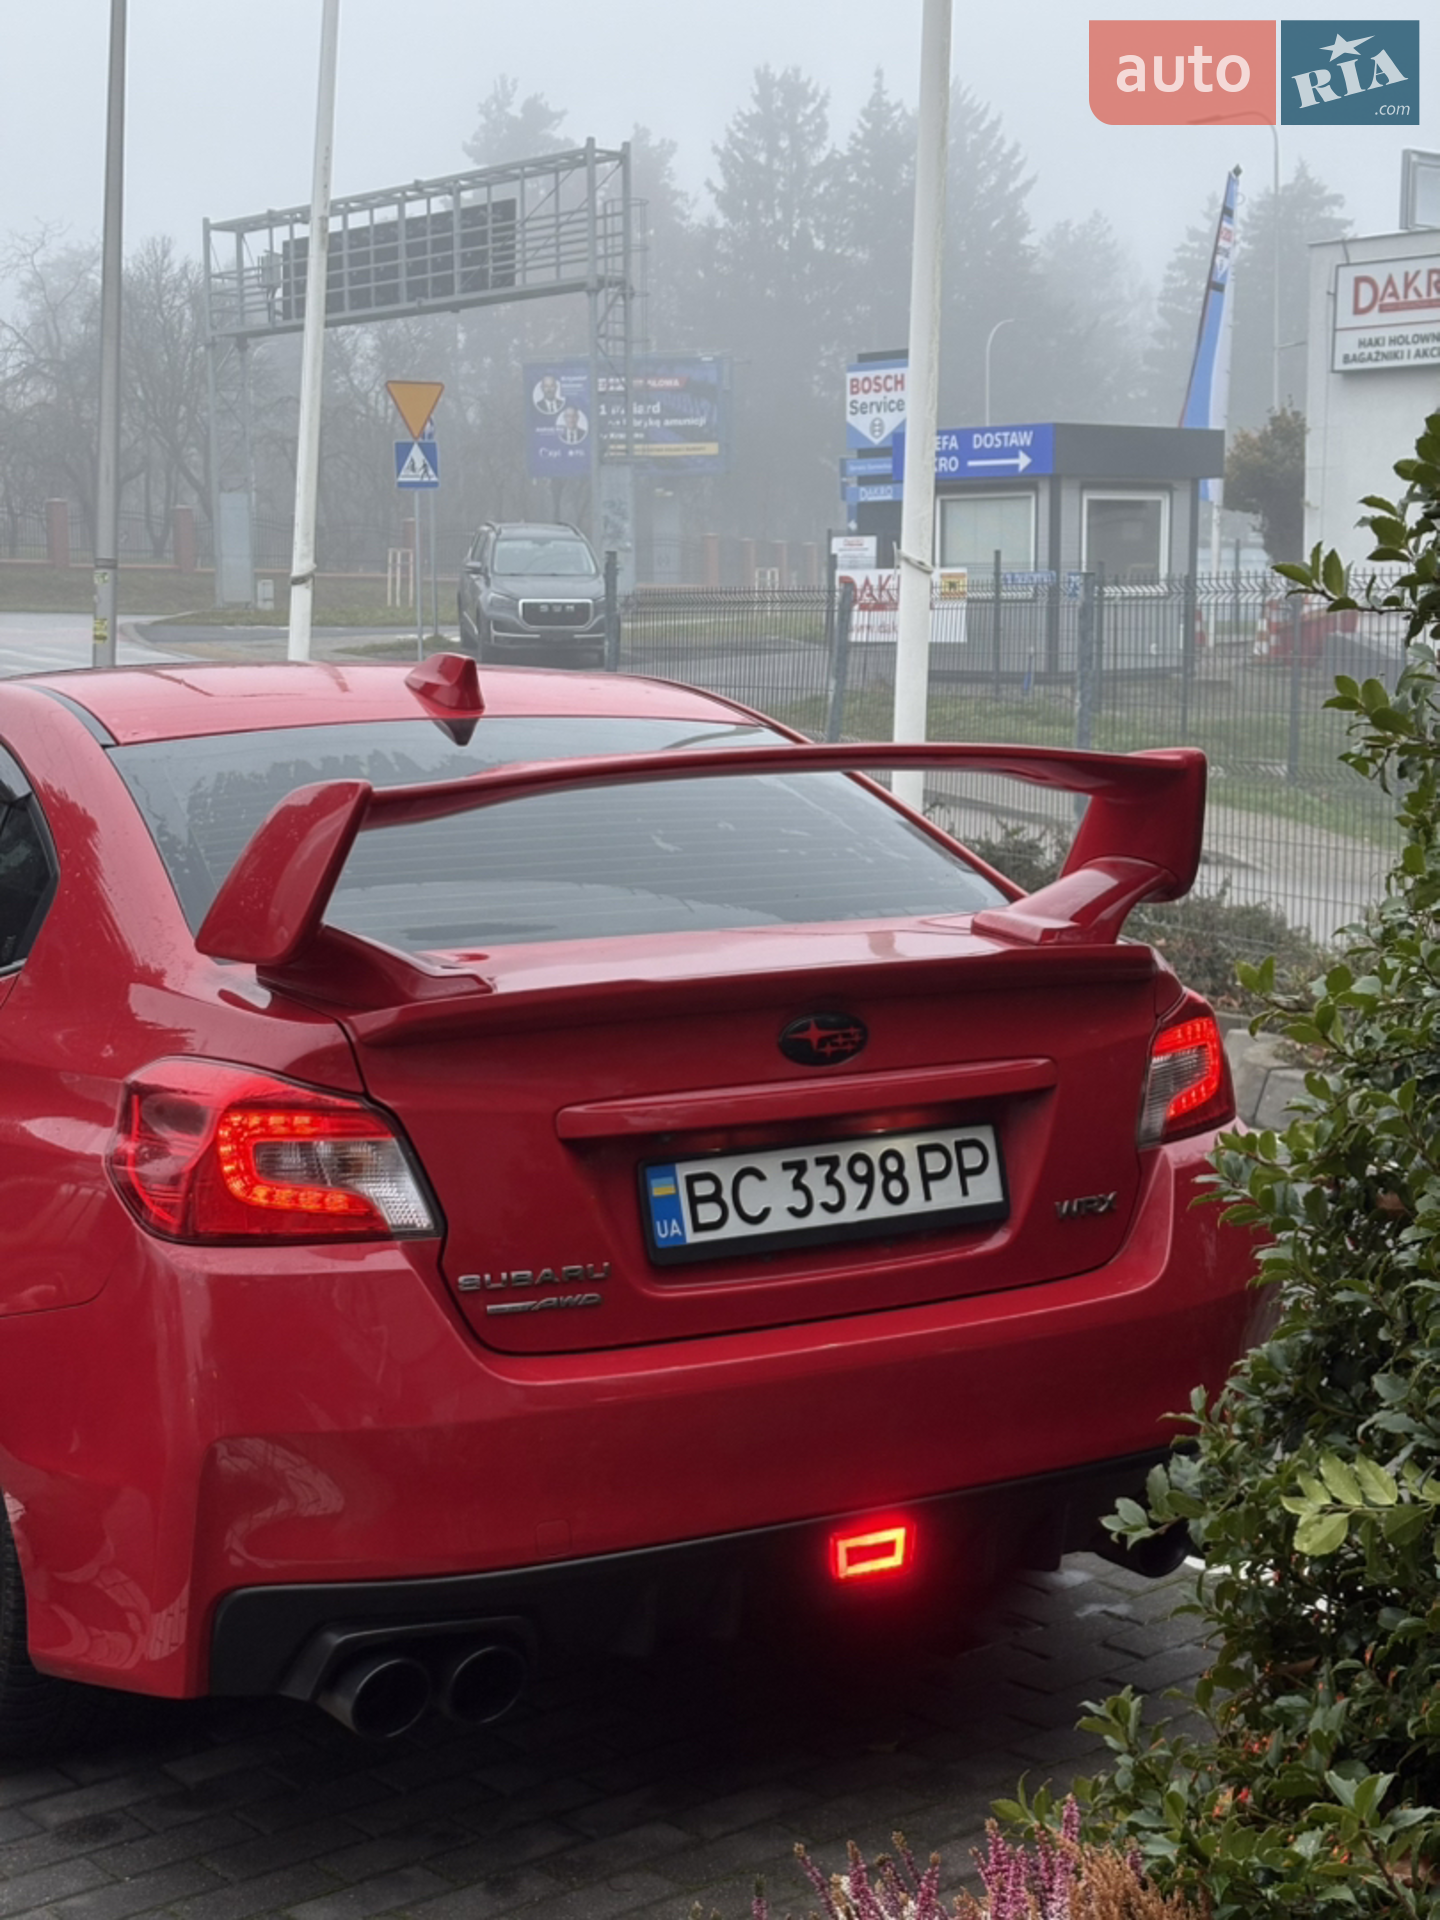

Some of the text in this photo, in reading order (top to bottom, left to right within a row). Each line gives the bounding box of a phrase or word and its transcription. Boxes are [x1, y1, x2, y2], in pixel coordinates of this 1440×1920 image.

[1358, 334, 1386, 350] HAKI
[850, 373, 905, 396] BOSCH
[849, 396, 905, 416] Service
[935, 431, 1034, 451] EFA DOSTAW
[684, 1137, 990, 1234] BC 3398 PP
[1054, 1191, 1117, 1218] WRX
[656, 1218, 682, 1239] UA
[457, 1262, 611, 1292] SUBARU
